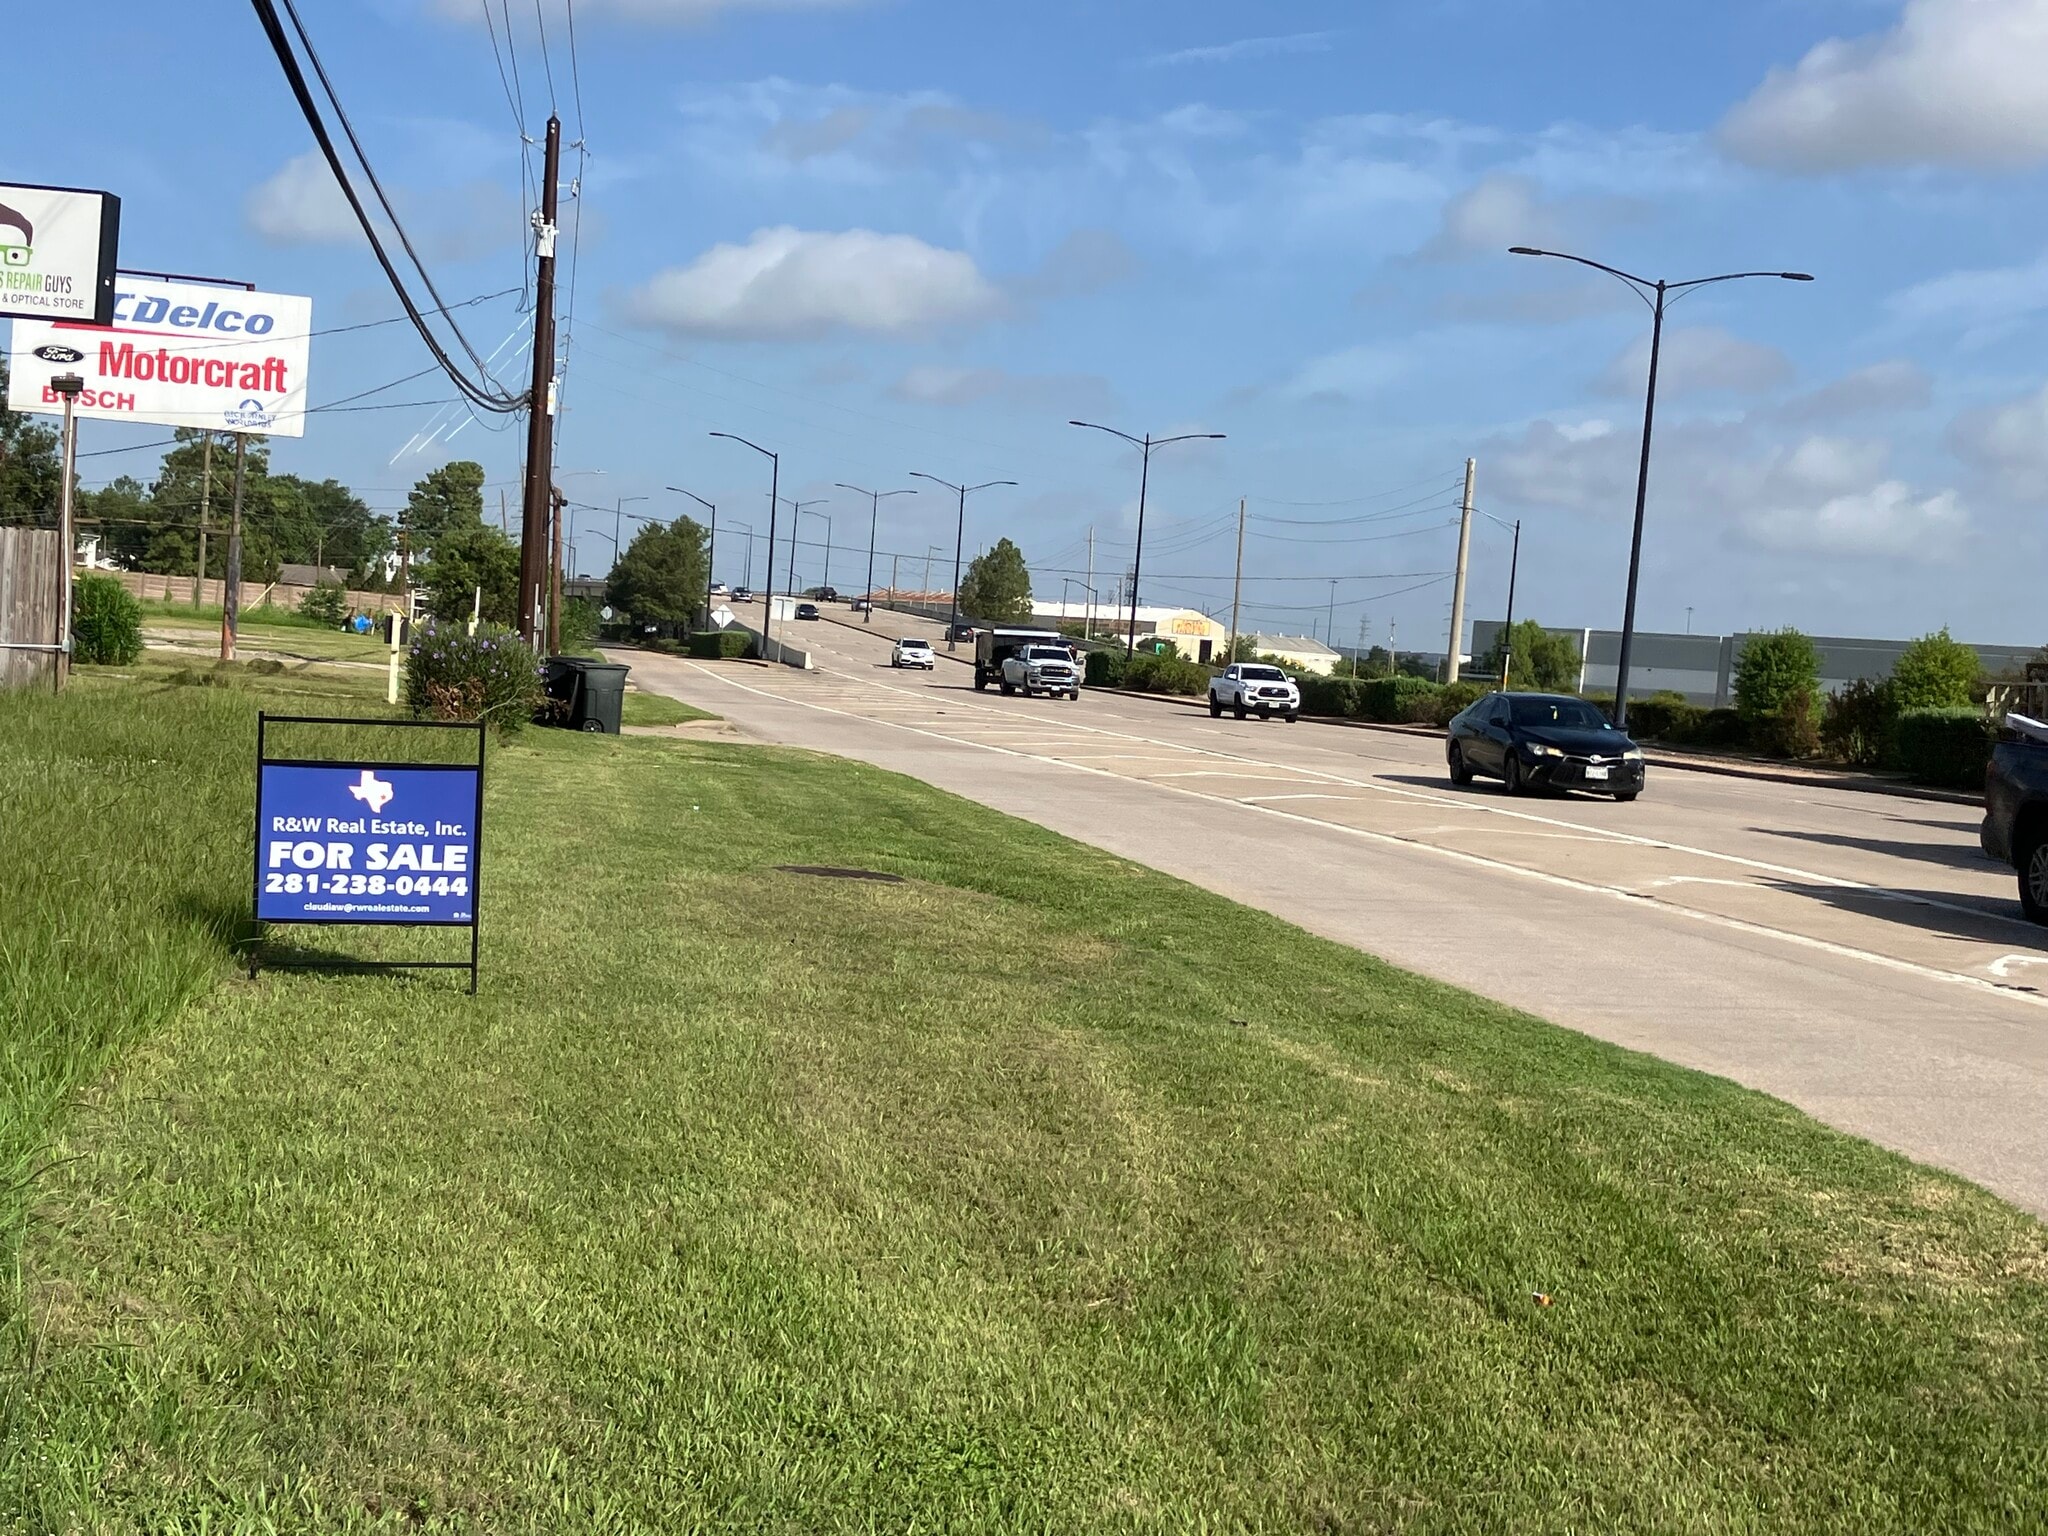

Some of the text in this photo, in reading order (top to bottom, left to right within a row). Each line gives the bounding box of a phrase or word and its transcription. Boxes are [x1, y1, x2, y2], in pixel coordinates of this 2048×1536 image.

[6, 271, 43, 291] REPAIR
[45, 274, 72, 294] GUYS
[2, 293, 84, 309] & OPTICAL STORE
[42, 340, 288, 393] Ford Motorcraft
[272, 816, 467, 838] R&W Real Estate, Inc.
[268, 841, 469, 872] FOR SALE
[264, 873, 469, 896] 281-238-0444
